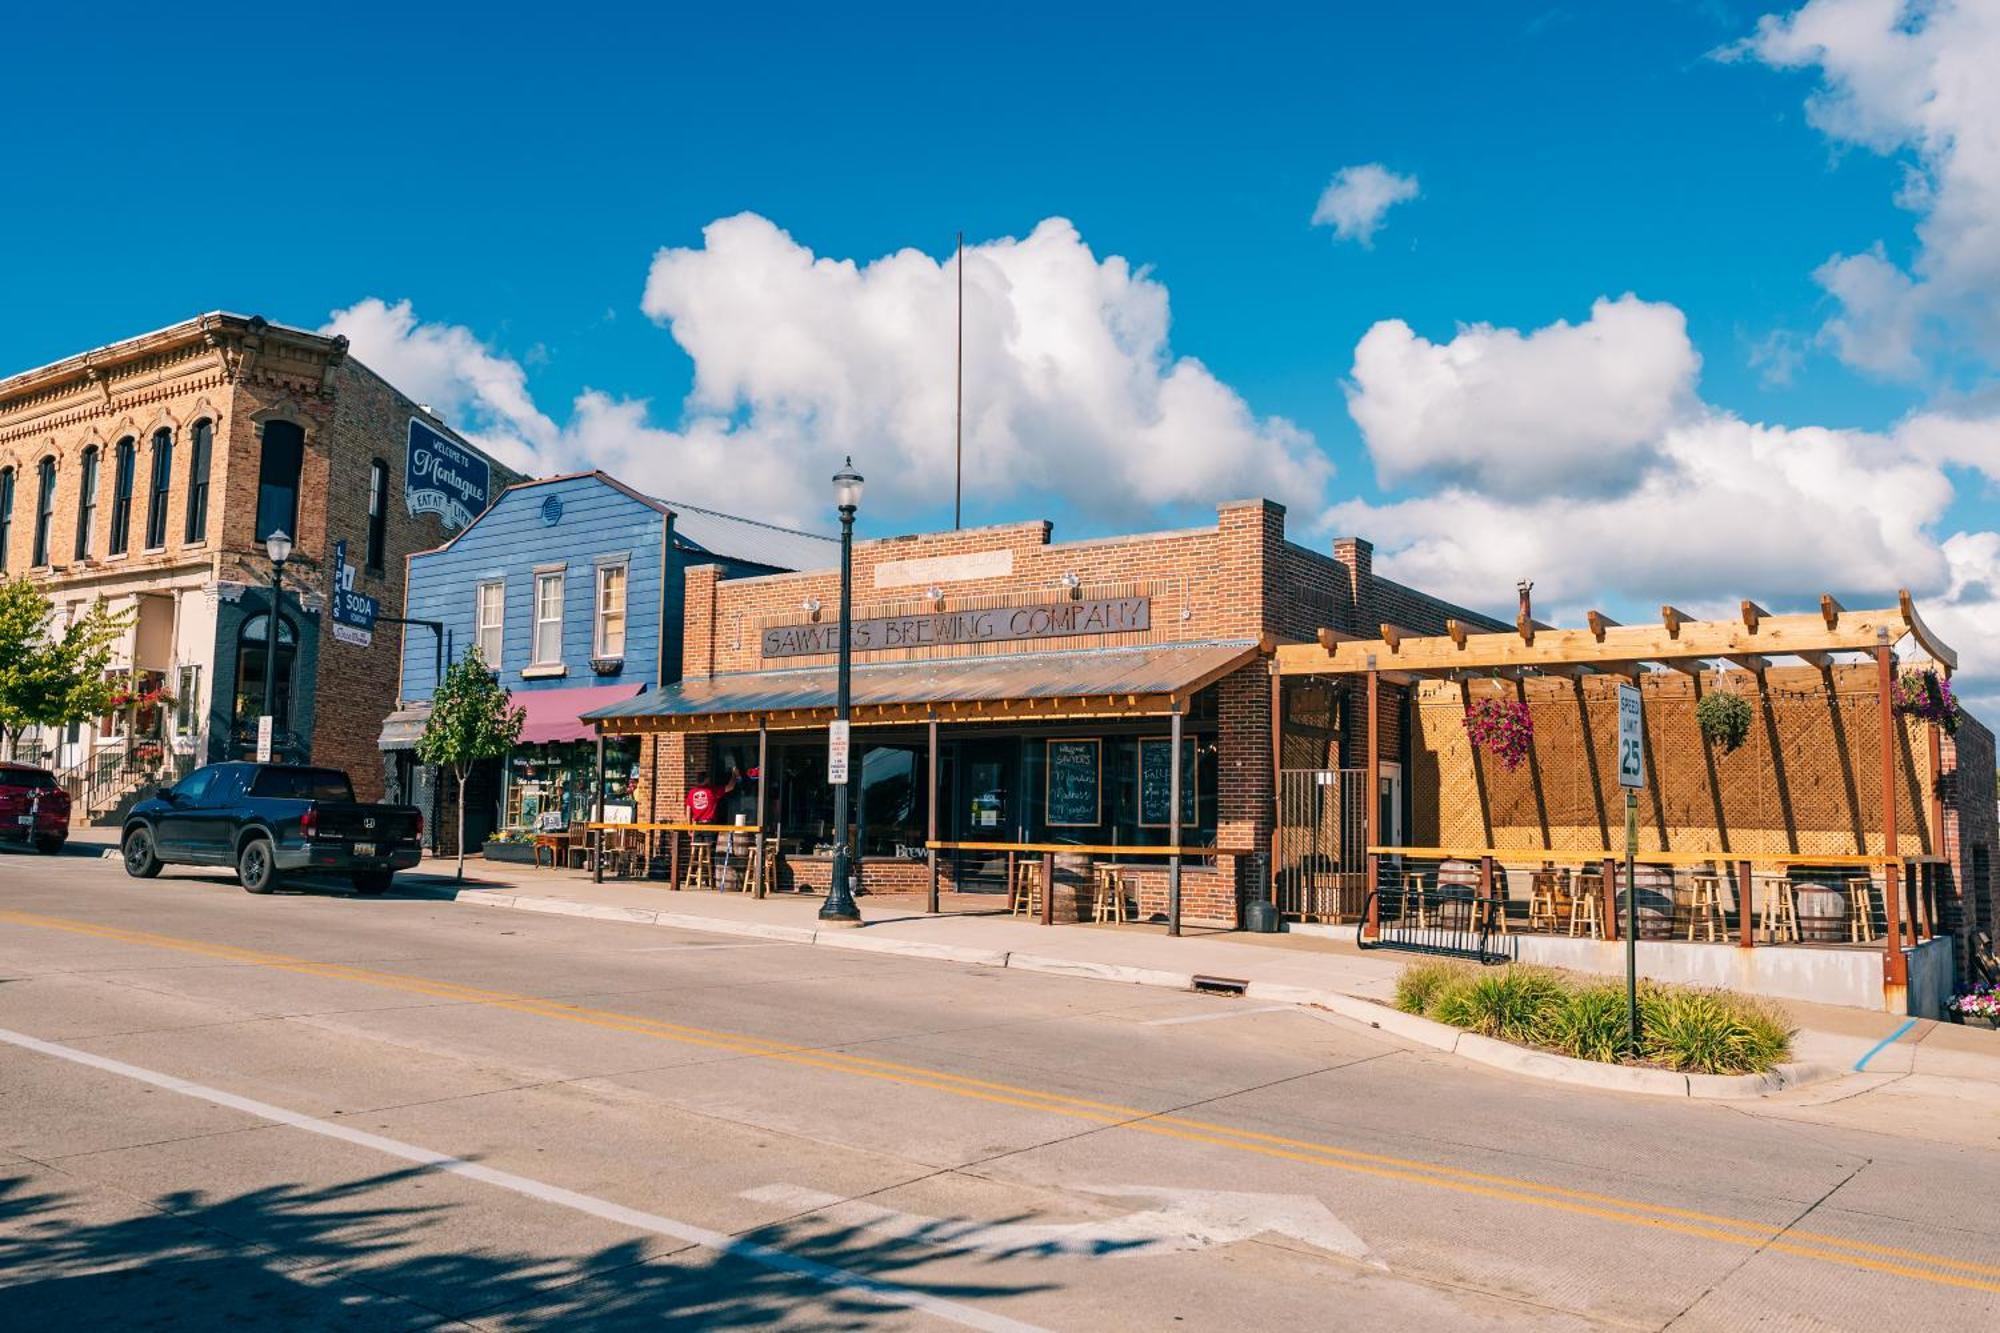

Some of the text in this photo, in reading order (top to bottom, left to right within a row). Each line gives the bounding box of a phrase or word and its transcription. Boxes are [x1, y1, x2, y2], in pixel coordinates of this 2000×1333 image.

[433, 440, 460, 464] WELCOME
[412, 449, 485, 501] Montague
[417, 493, 433, 507] EAT
[345, 594, 372, 616] SODA
[764, 600, 1142, 654] SAWYES BREWING COMPANY
[1621, 696, 1639, 715] SPEED
[1623, 717, 1638, 733] LIMIT
[1622, 738, 1640, 777] 25
